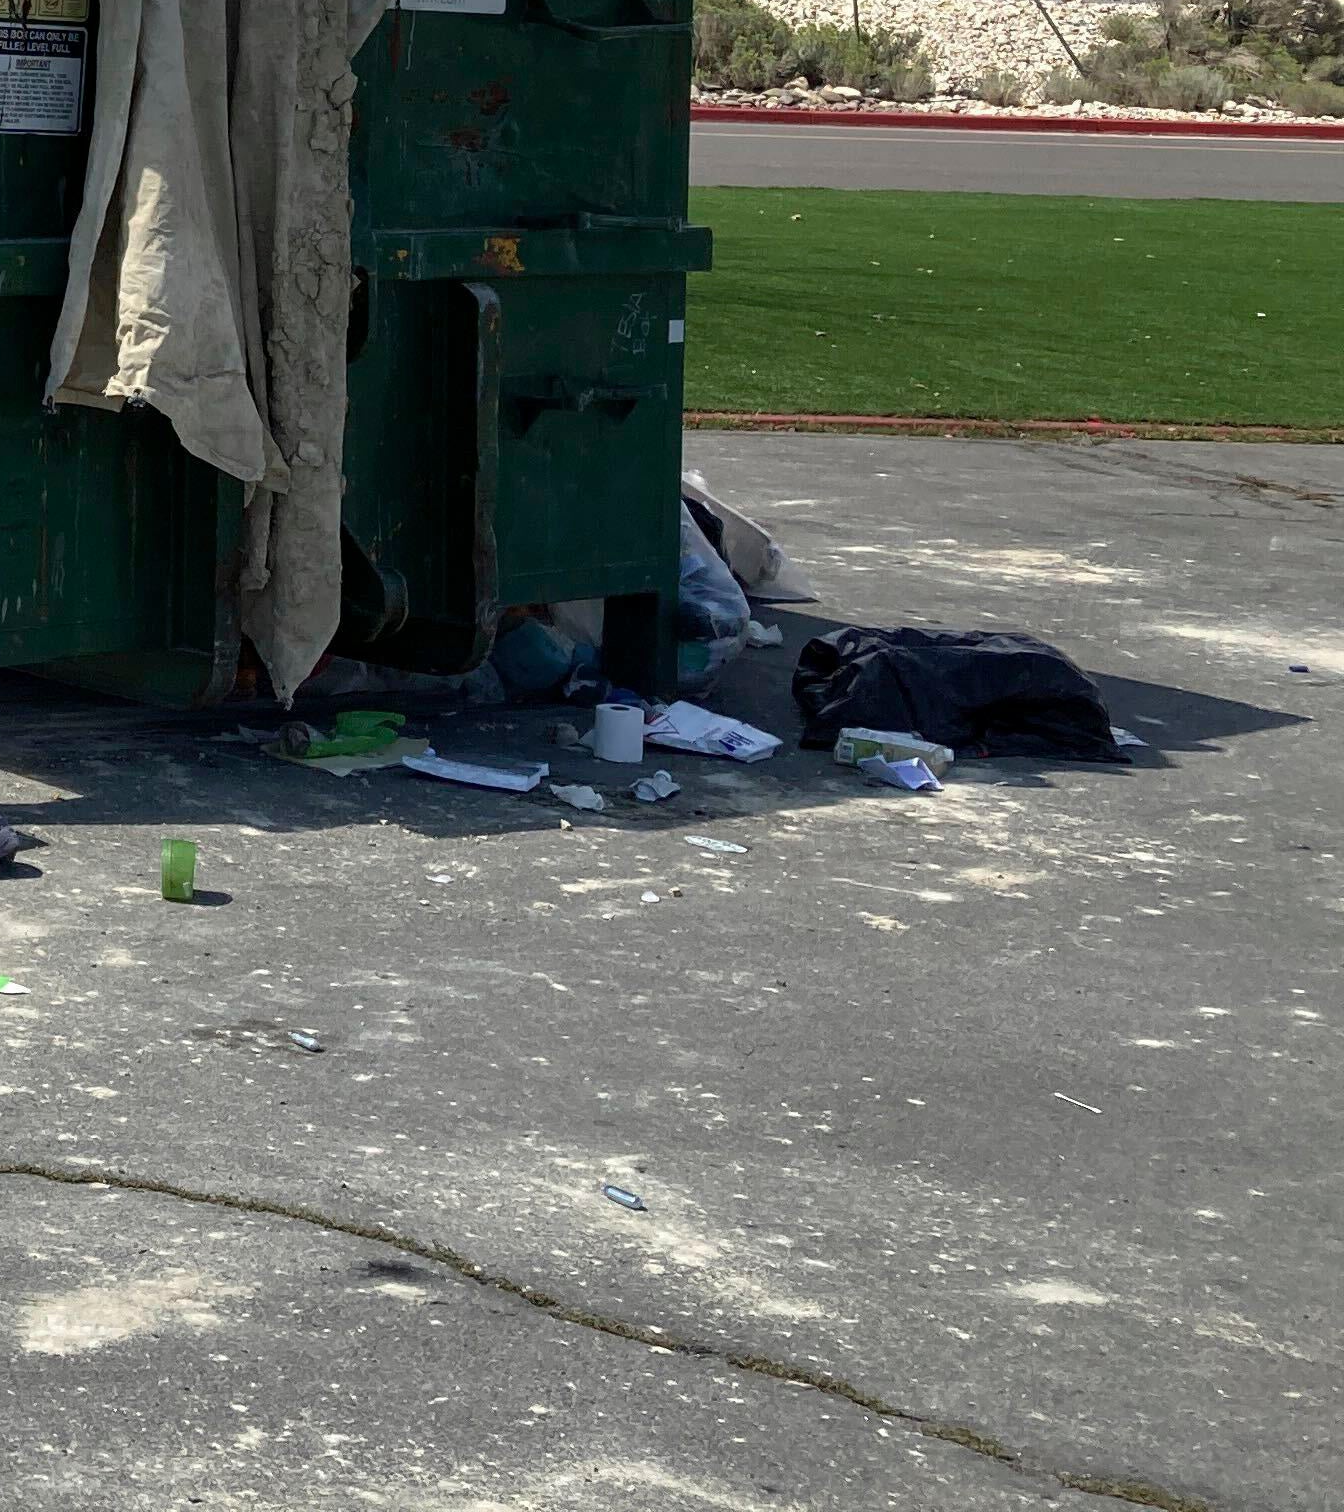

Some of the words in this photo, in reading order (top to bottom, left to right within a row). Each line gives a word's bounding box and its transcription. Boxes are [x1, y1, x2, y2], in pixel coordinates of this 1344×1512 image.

[29, 31, 46, 40] CAN
[46, 32, 66, 41] ONLY
[26, 42, 50, 52] LEVEL
[51, 43, 71, 53] FULL
